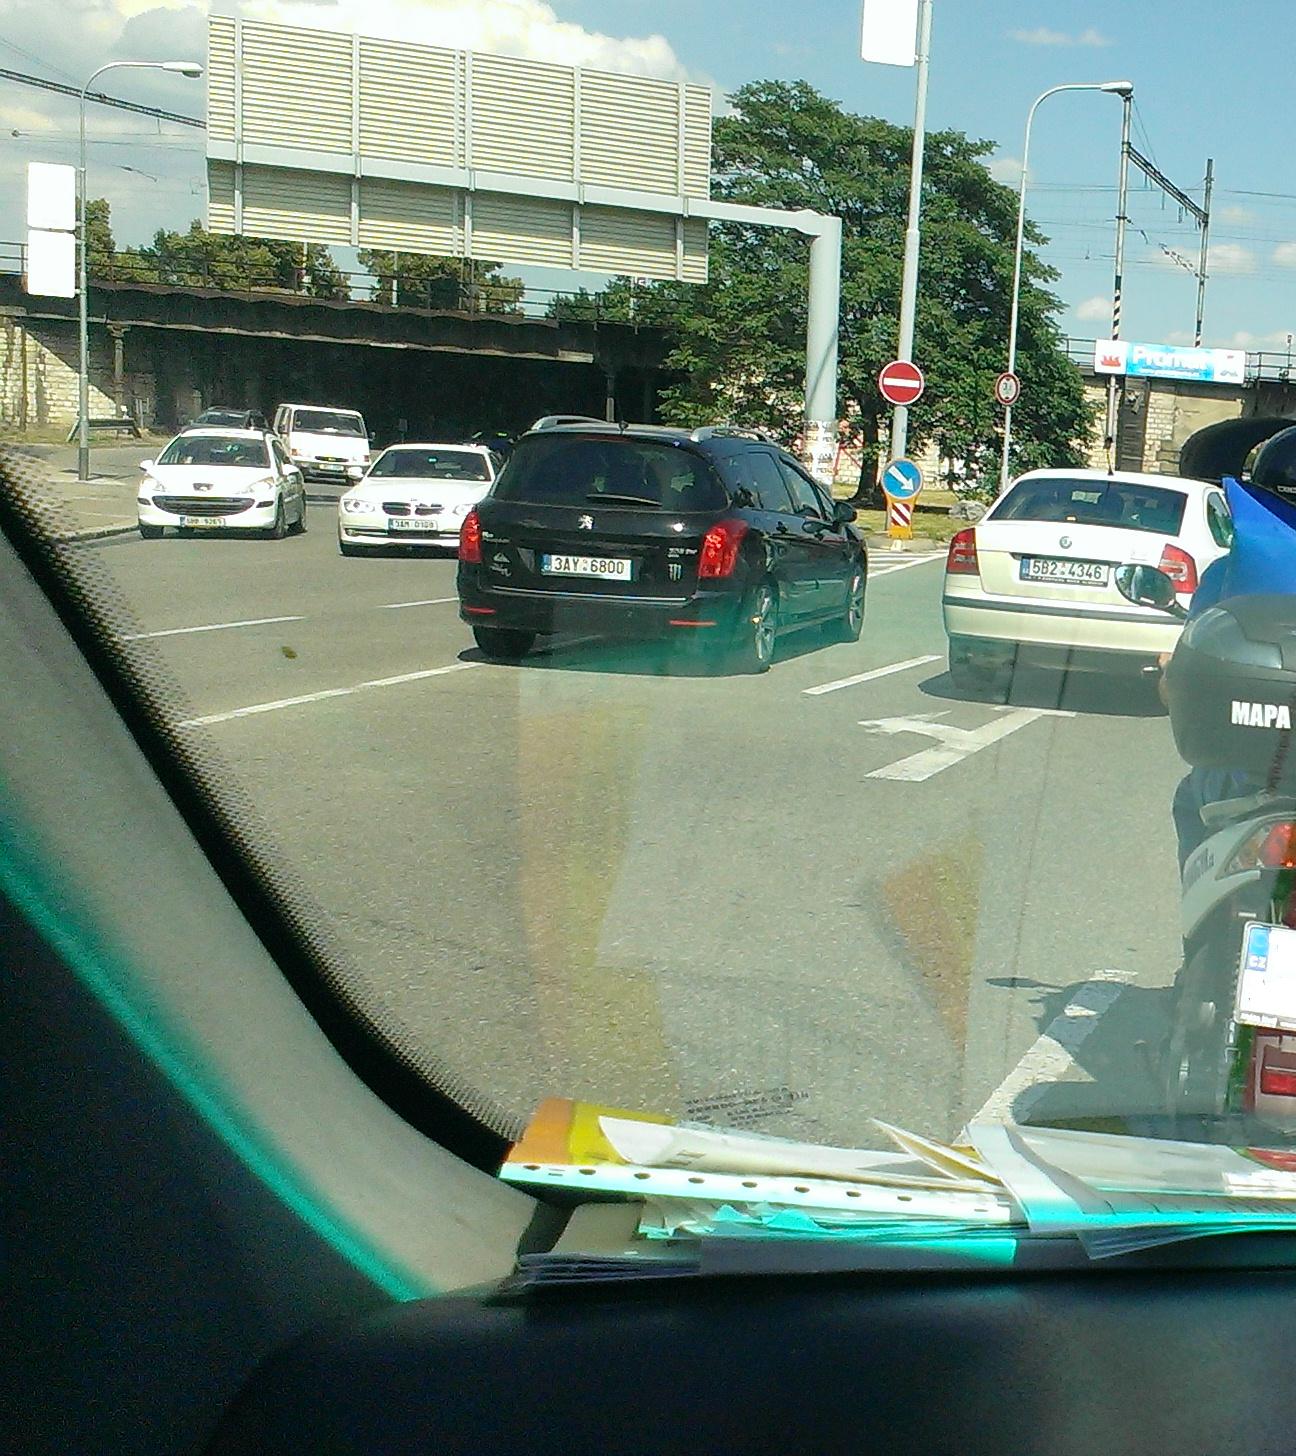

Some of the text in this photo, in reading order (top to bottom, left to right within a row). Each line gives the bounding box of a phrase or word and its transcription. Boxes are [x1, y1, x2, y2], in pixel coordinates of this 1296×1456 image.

[554, 557, 625, 575] 3AY 6800
[1032, 560, 1102, 580] 5B2 4346
[1231, 700, 1292, 729] MAPA
